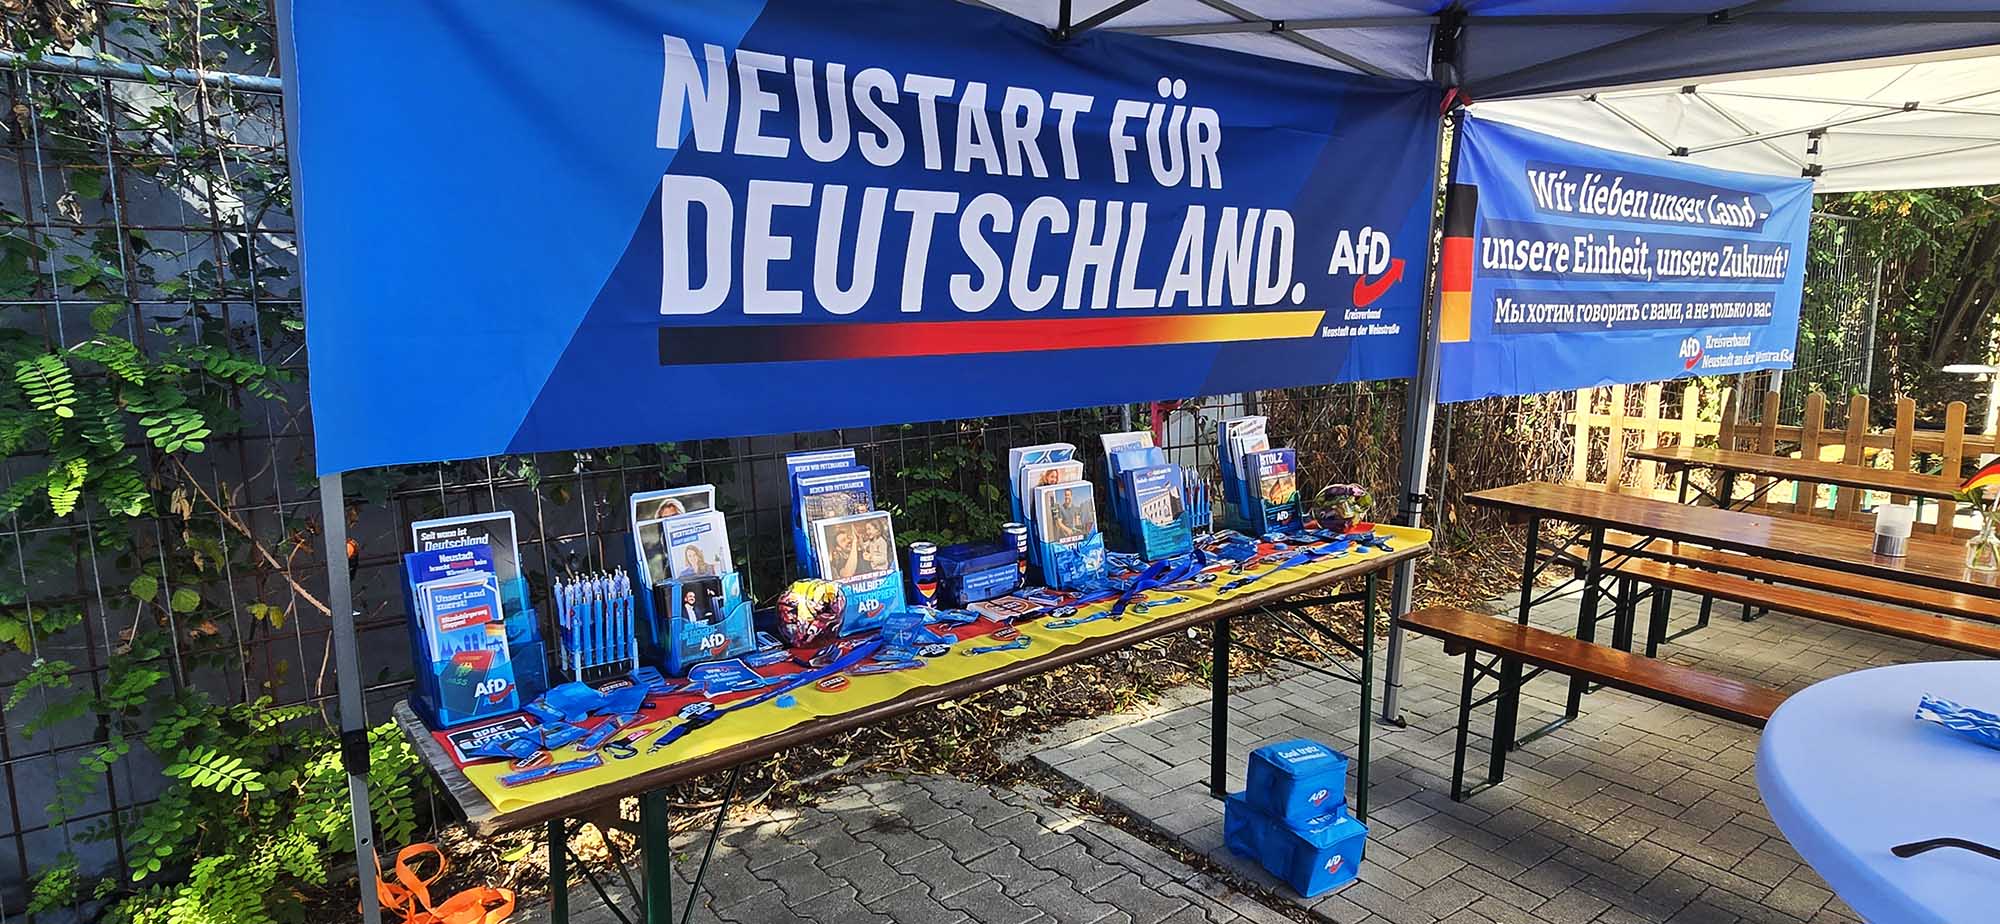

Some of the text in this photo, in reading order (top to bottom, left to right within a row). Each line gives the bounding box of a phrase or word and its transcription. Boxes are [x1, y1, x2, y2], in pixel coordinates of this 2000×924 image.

[656, 34, 1222, 189] NEUSTART FÜR
[1527, 169, 1577, 212] Wir
[1578, 172, 1649, 218] lieben
[1649, 192, 1706, 223] unser
[1707, 194, 1756, 228] Land
[660, 174, 1306, 315] DEUTSCHLAND.
[1328, 226, 1391, 275] AfD
[1482, 233, 1789, 282] unsere Einheit, unsere Zukunft!
[1344, 308, 1382, 321] Kreisverband
[1494, 297, 1526, 324] Мы
[1526, 303, 1575, 323] хотим
[1576, 302, 1639, 328] говорить
[1641, 303, 1649, 320] с
[1649, 302, 1684, 324] вами,
[1685, 303, 1693, 319] а
[1694, 303, 1708, 320] не
[1709, 302, 1745, 319] только
[1746, 303, 1753, 318] о
[1322, 323, 1401, 338] Neustadt an der Weinstraße
[1679, 332, 1752, 358] AfD Kreisverband
[1701, 352, 1734, 368] Neustadt
[1734, 355, 1743, 366] an
[1743, 351, 1755, 365] der
[457, 527, 467, 536] ist
[425, 533, 489, 552] Deutschland
[439, 550, 474, 563] Neustadt
[435, 588, 486, 603] Unser Land
[858, 599, 880, 613] AfD
[700, 633, 725, 650] AfD
[474, 678, 507, 698] AfD
[1308, 789, 1328, 803] AfD
[1324, 854, 1342, 870] AfD
